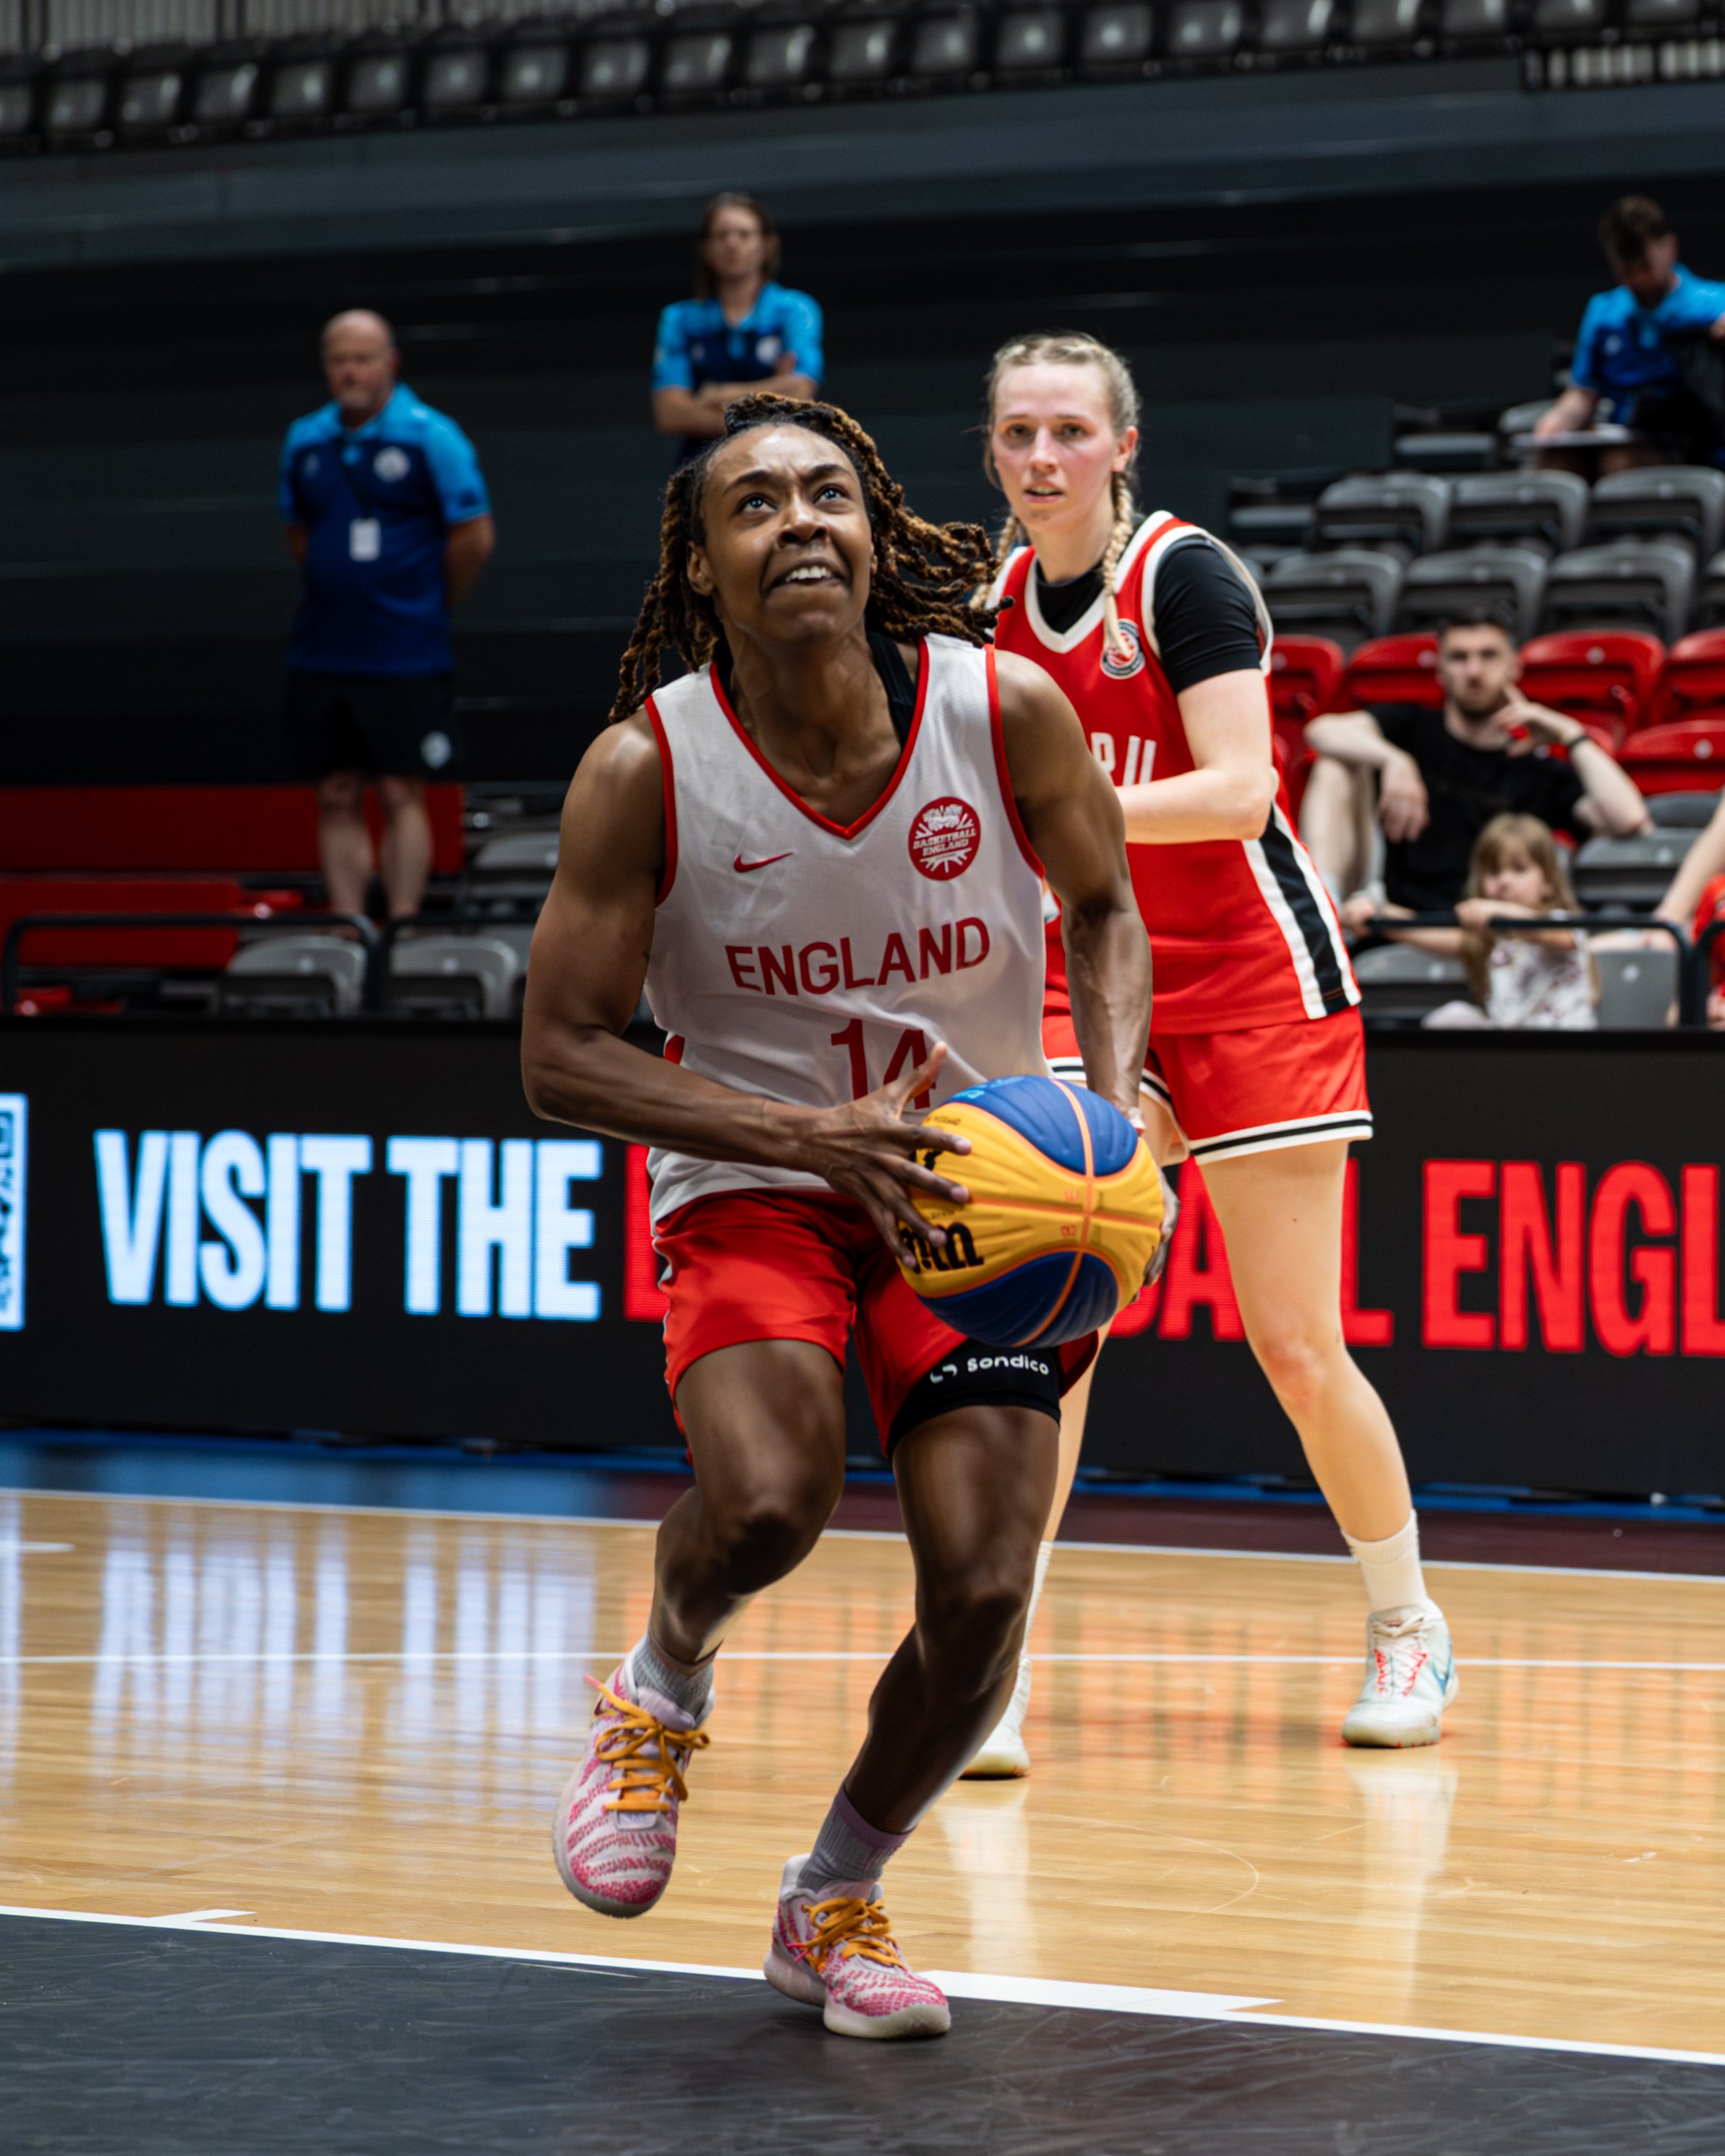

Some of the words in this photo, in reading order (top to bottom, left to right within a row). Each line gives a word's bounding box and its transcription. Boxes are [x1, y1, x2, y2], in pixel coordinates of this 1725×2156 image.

[923, 838, 969, 856] ENGLAND
[725, 916, 990, 995] ENGLAND
[831, 1018, 936, 1109] 14
[93, 1128, 373, 1312] VISIT
[386, 1135, 603, 1322] THE
[967, 1354, 1050, 1376] sondico
